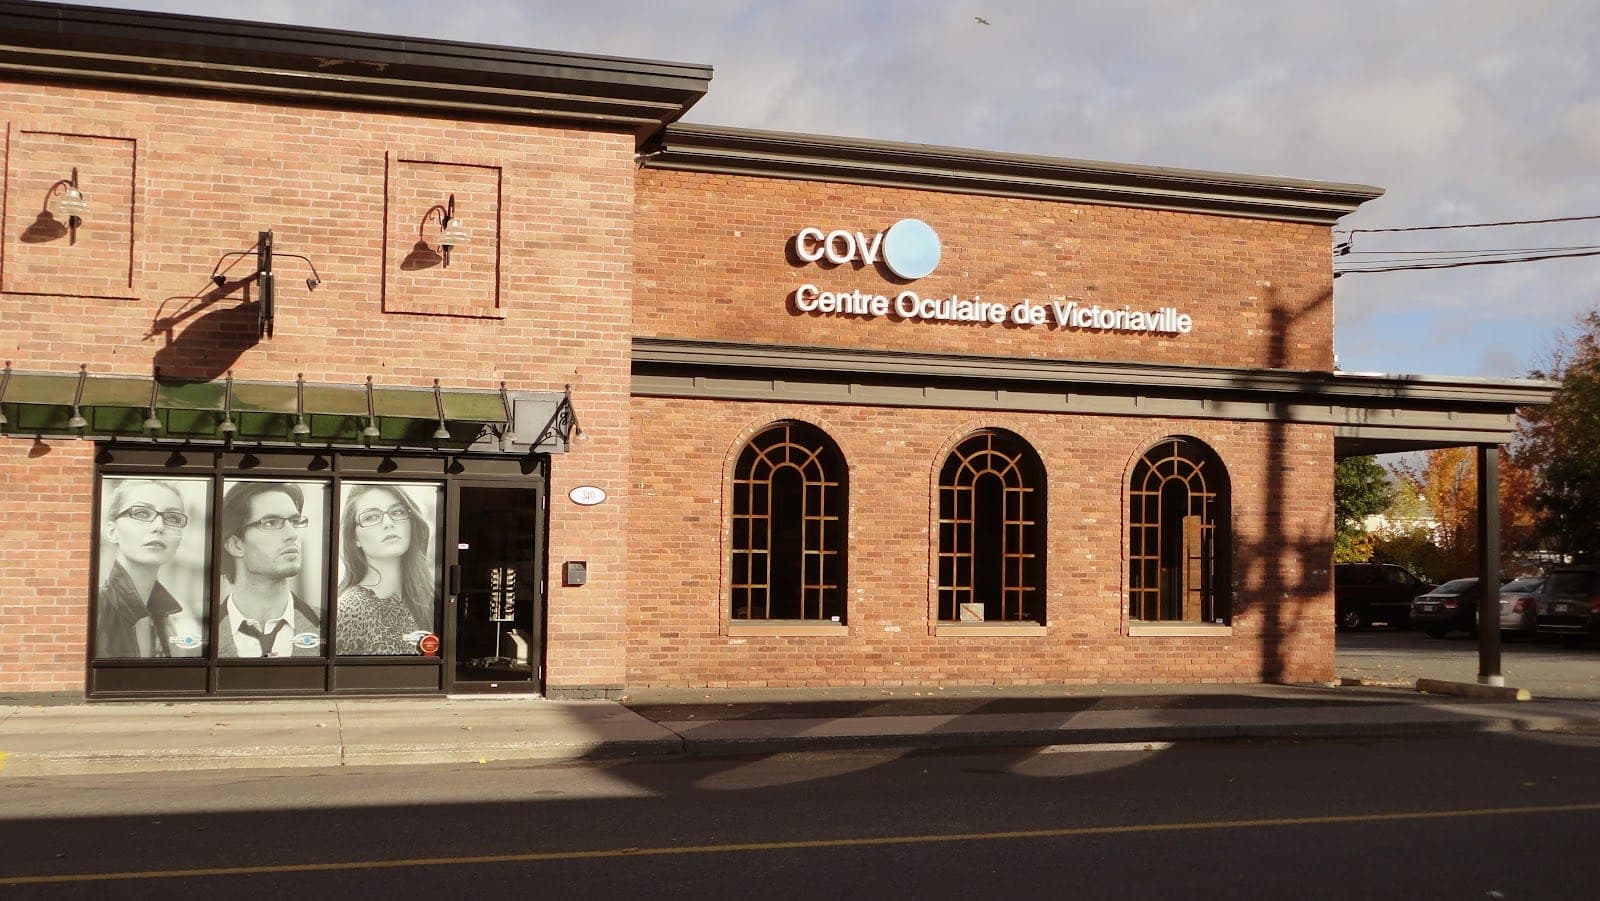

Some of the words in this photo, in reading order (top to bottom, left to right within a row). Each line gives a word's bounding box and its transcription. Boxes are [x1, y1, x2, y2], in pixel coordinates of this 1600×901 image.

[796, 227, 883, 265] COV
[795, 284, 889, 316] Centre
[895, 291, 1006, 323] Oculaire
[1011, 299, 1047, 325] de
[1052, 301, 1193, 333] Victoriaville
